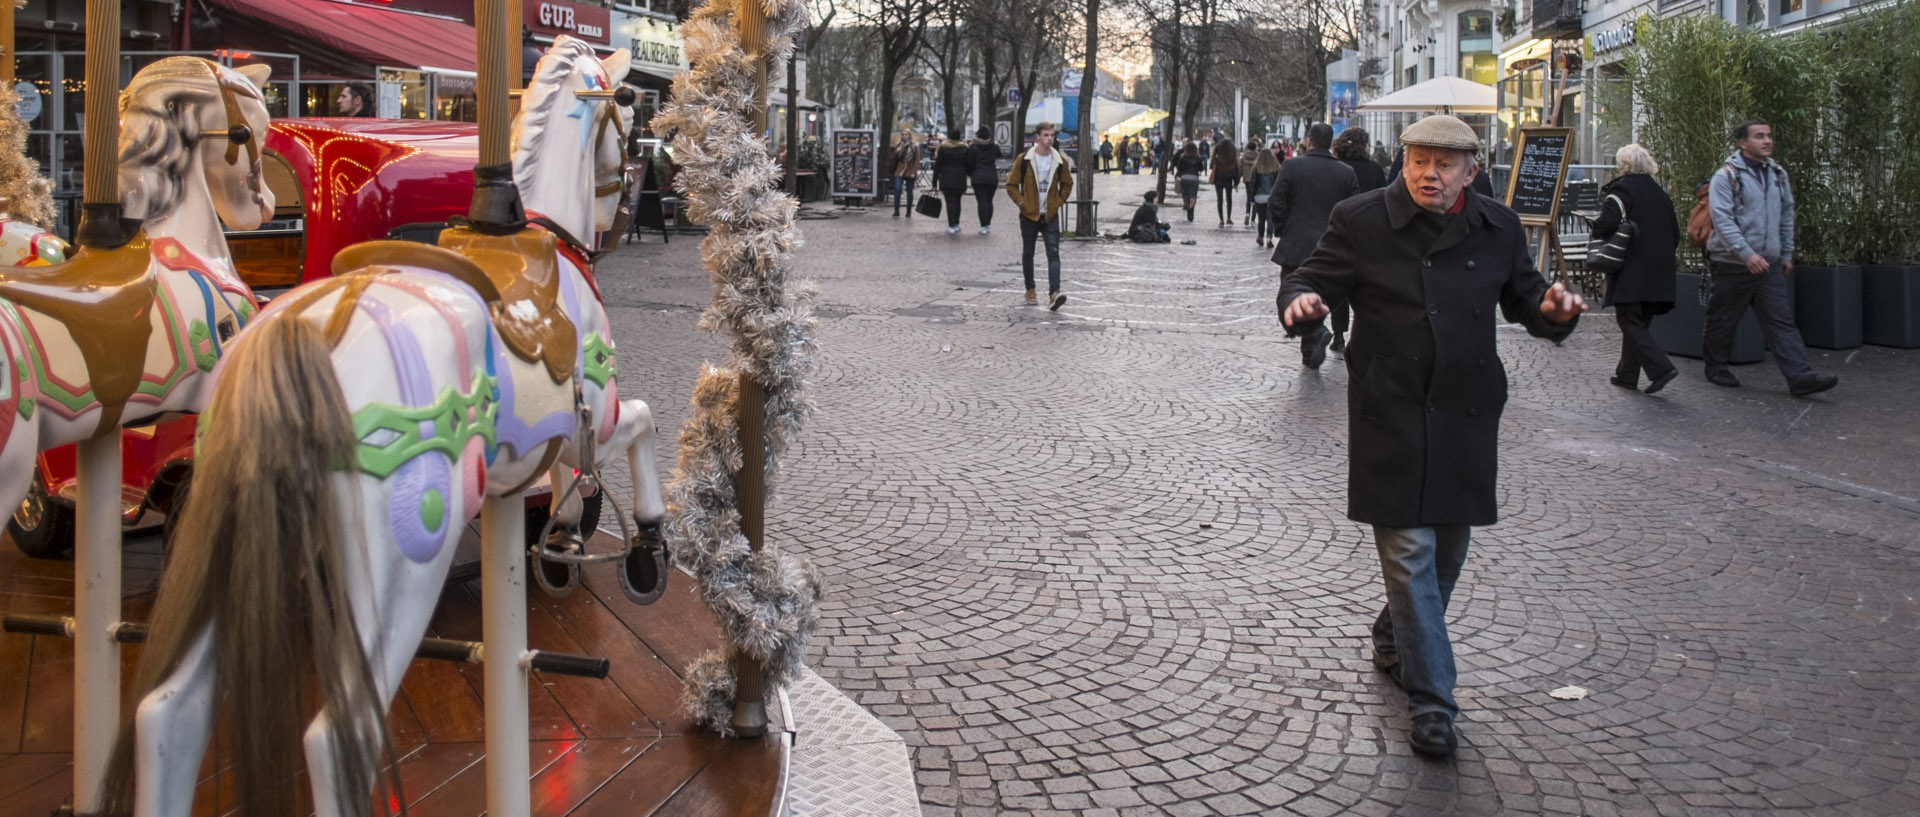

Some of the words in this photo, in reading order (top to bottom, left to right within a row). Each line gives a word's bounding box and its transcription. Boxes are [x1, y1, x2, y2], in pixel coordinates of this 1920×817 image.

[539, 2, 576, 30] GUR
[577, 23, 602, 38] KEBAB
[631, 38, 680, 66] BEAUREPAIRE
